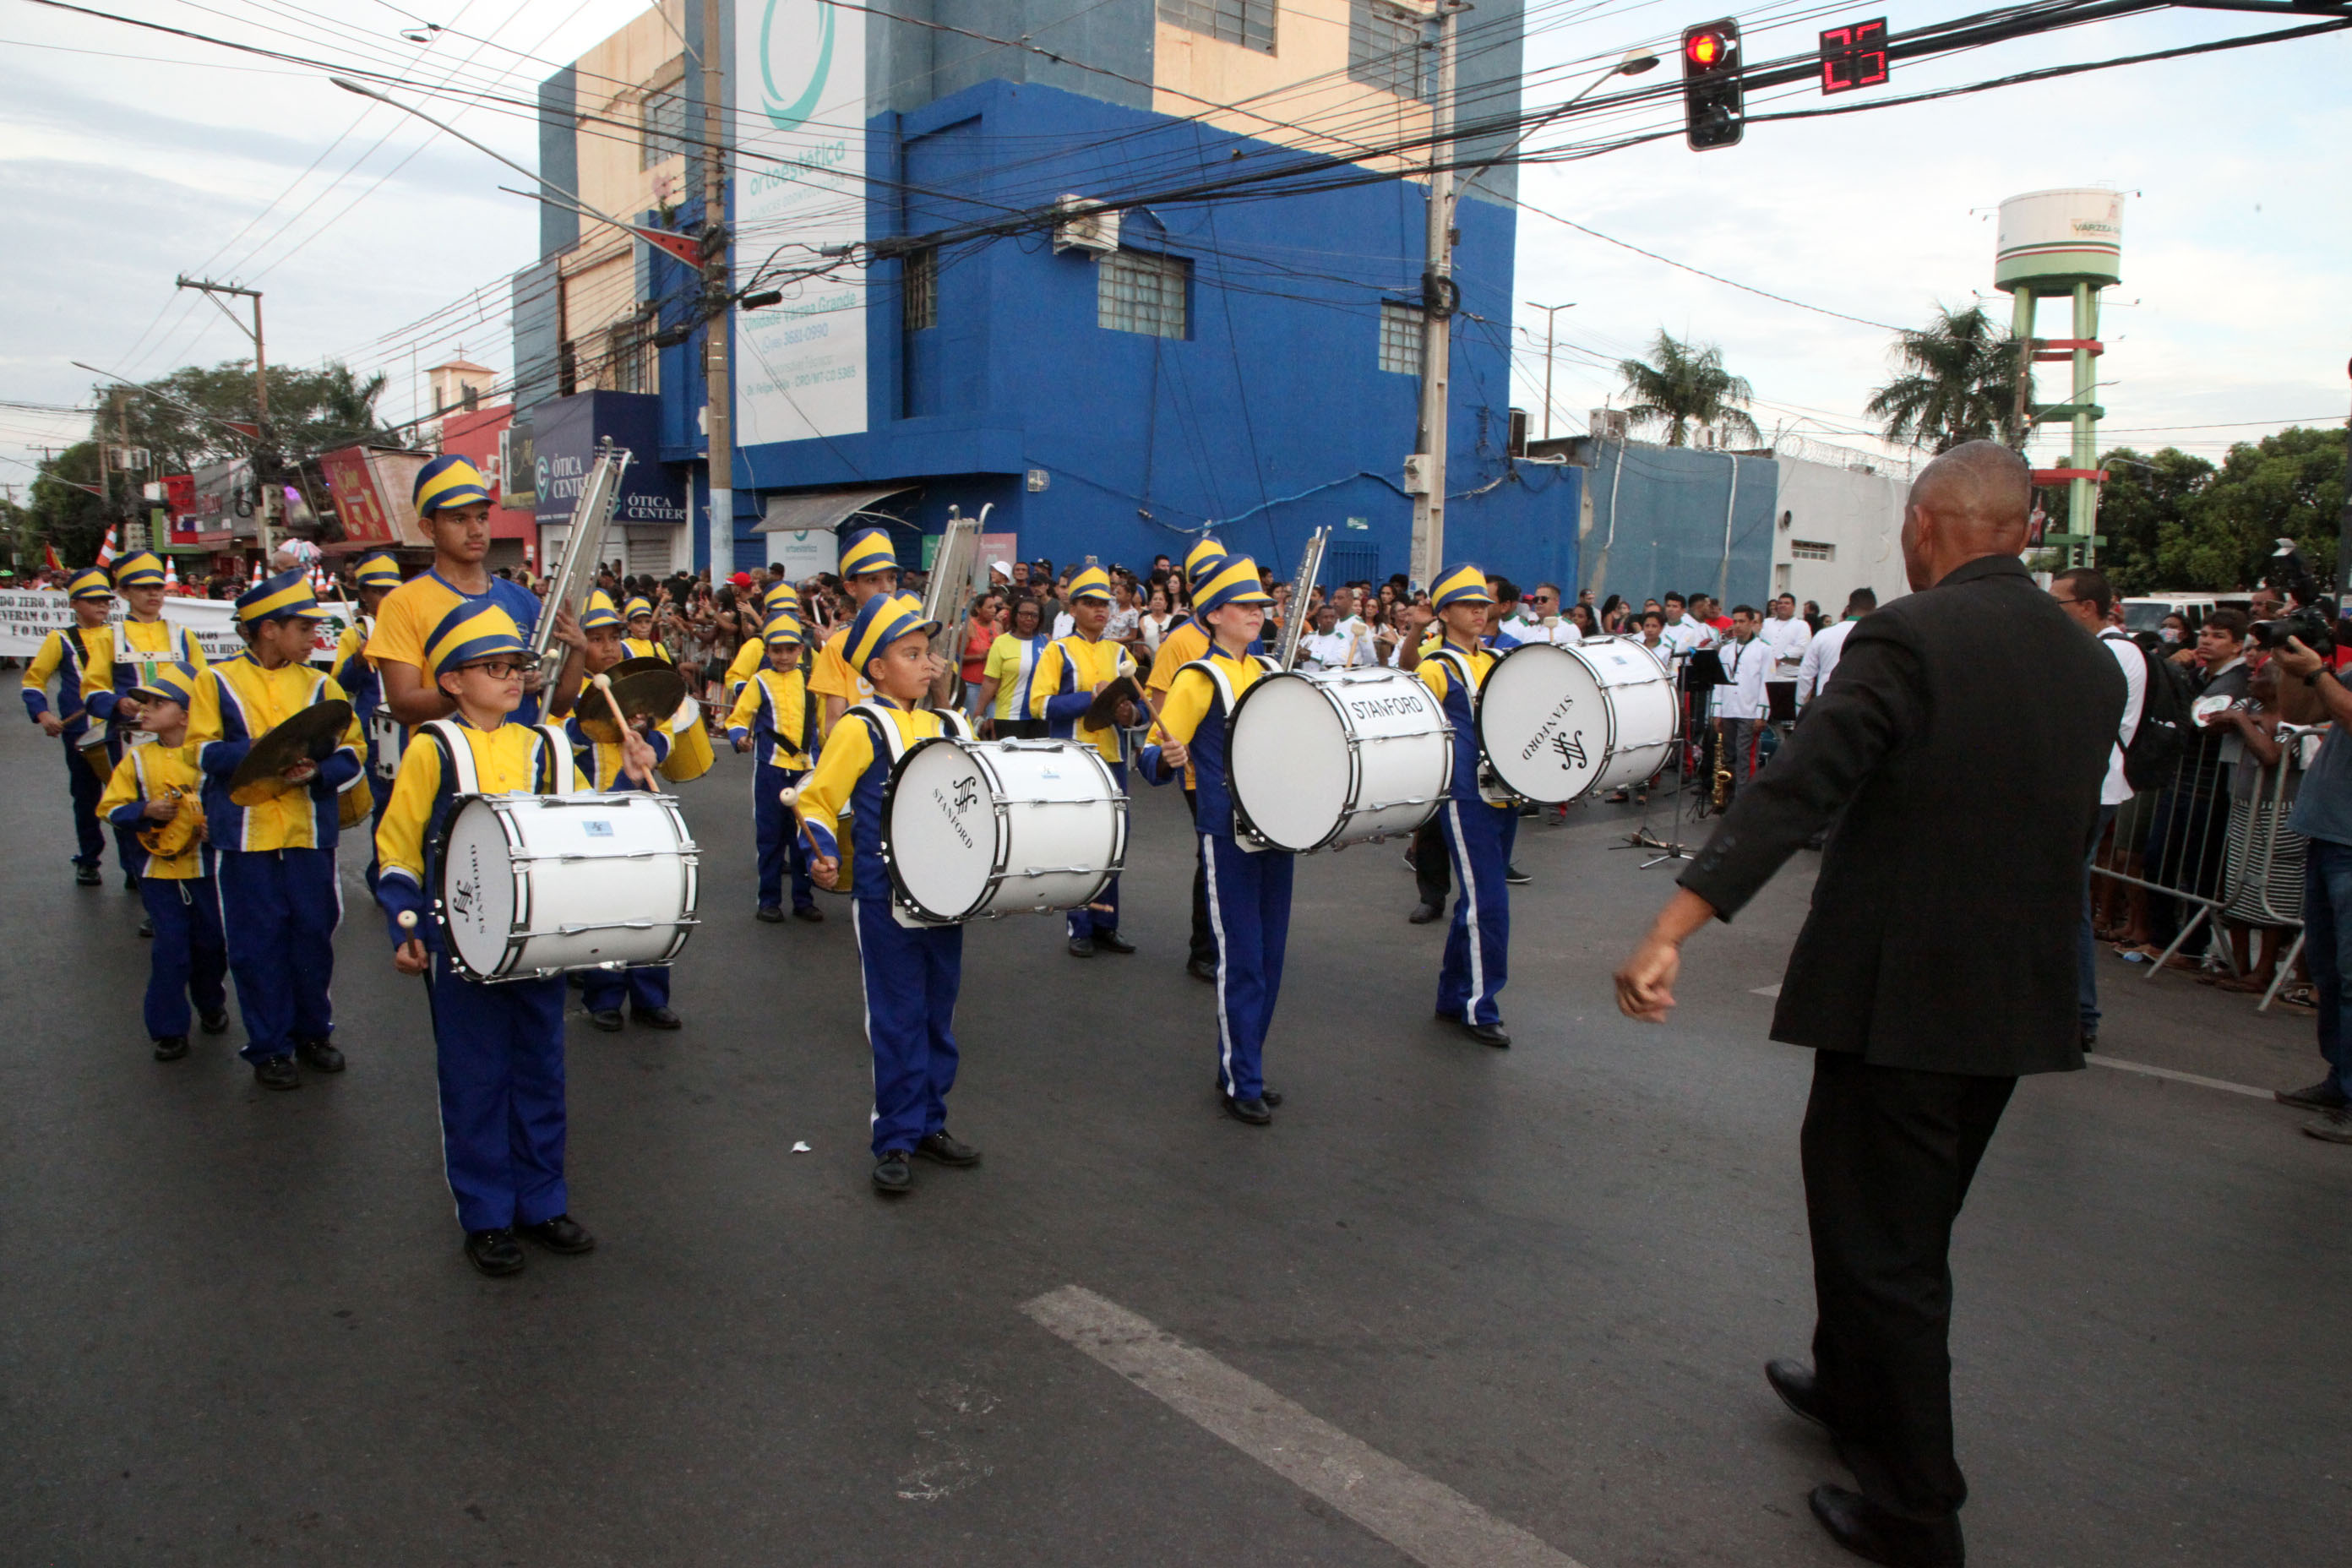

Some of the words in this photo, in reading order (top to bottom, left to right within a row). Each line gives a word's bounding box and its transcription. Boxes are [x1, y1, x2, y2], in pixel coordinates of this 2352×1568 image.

[553, 454, 583, 478] ÓTICA
[553, 476, 585, 498] CENTE
[628, 493, 672, 508] ÓTICA
[628, 507, 683, 520] CENTER
[1350, 695, 1424, 720] STANFORD
[1522, 694, 1574, 760] STANFORD
[932, 787, 973, 849] STANFORD
[471, 844, 486, 934] STANFORD
